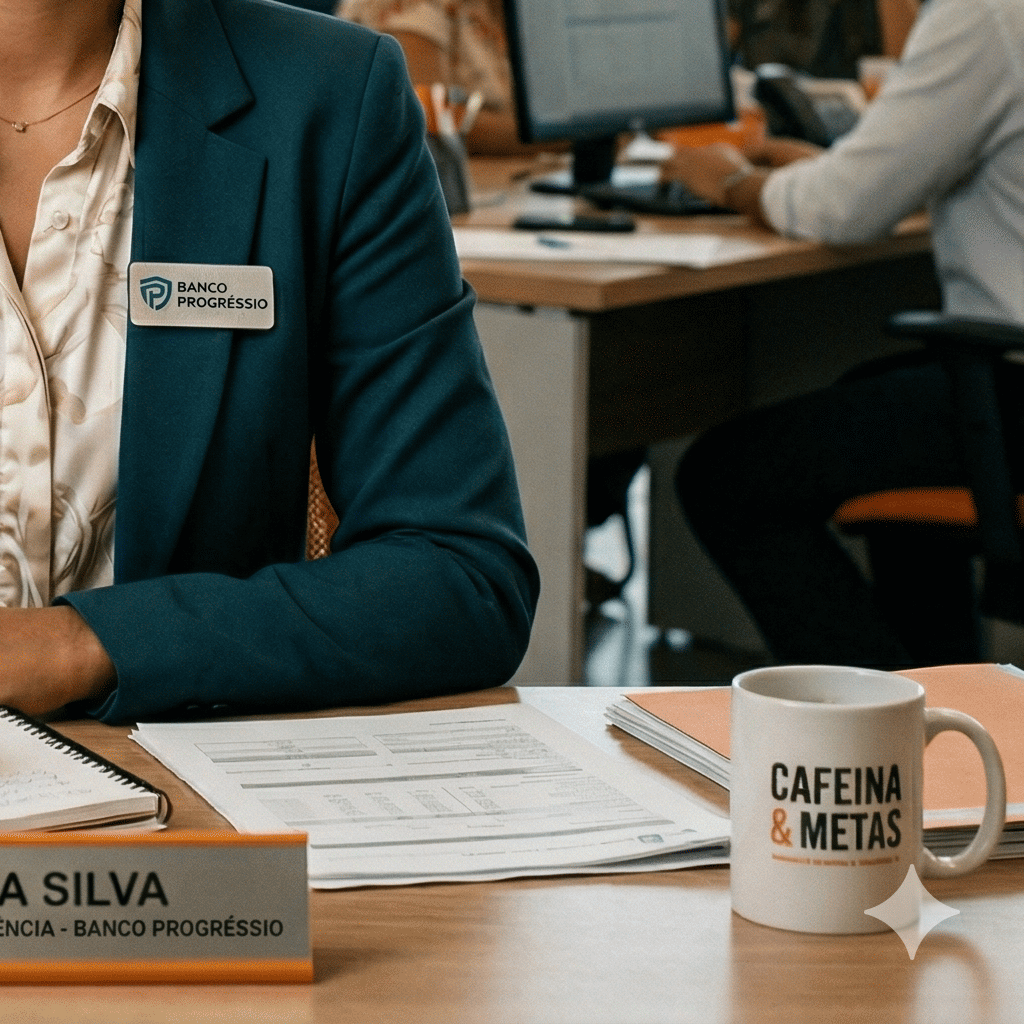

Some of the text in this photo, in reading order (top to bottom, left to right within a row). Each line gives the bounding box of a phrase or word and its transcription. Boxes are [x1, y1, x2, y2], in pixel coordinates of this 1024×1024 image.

[177, 281, 228, 294] BANCO
[177, 295, 268, 309] PROGRÉSSIO
[770, 762, 902, 805] CAFEINA
[770, 808, 902, 851] & METAS
[42, 871, 169, 907] SILVA
[73, 919, 146, 937] BANCO
[152, 915, 284, 937] PROGRÉSSIO
